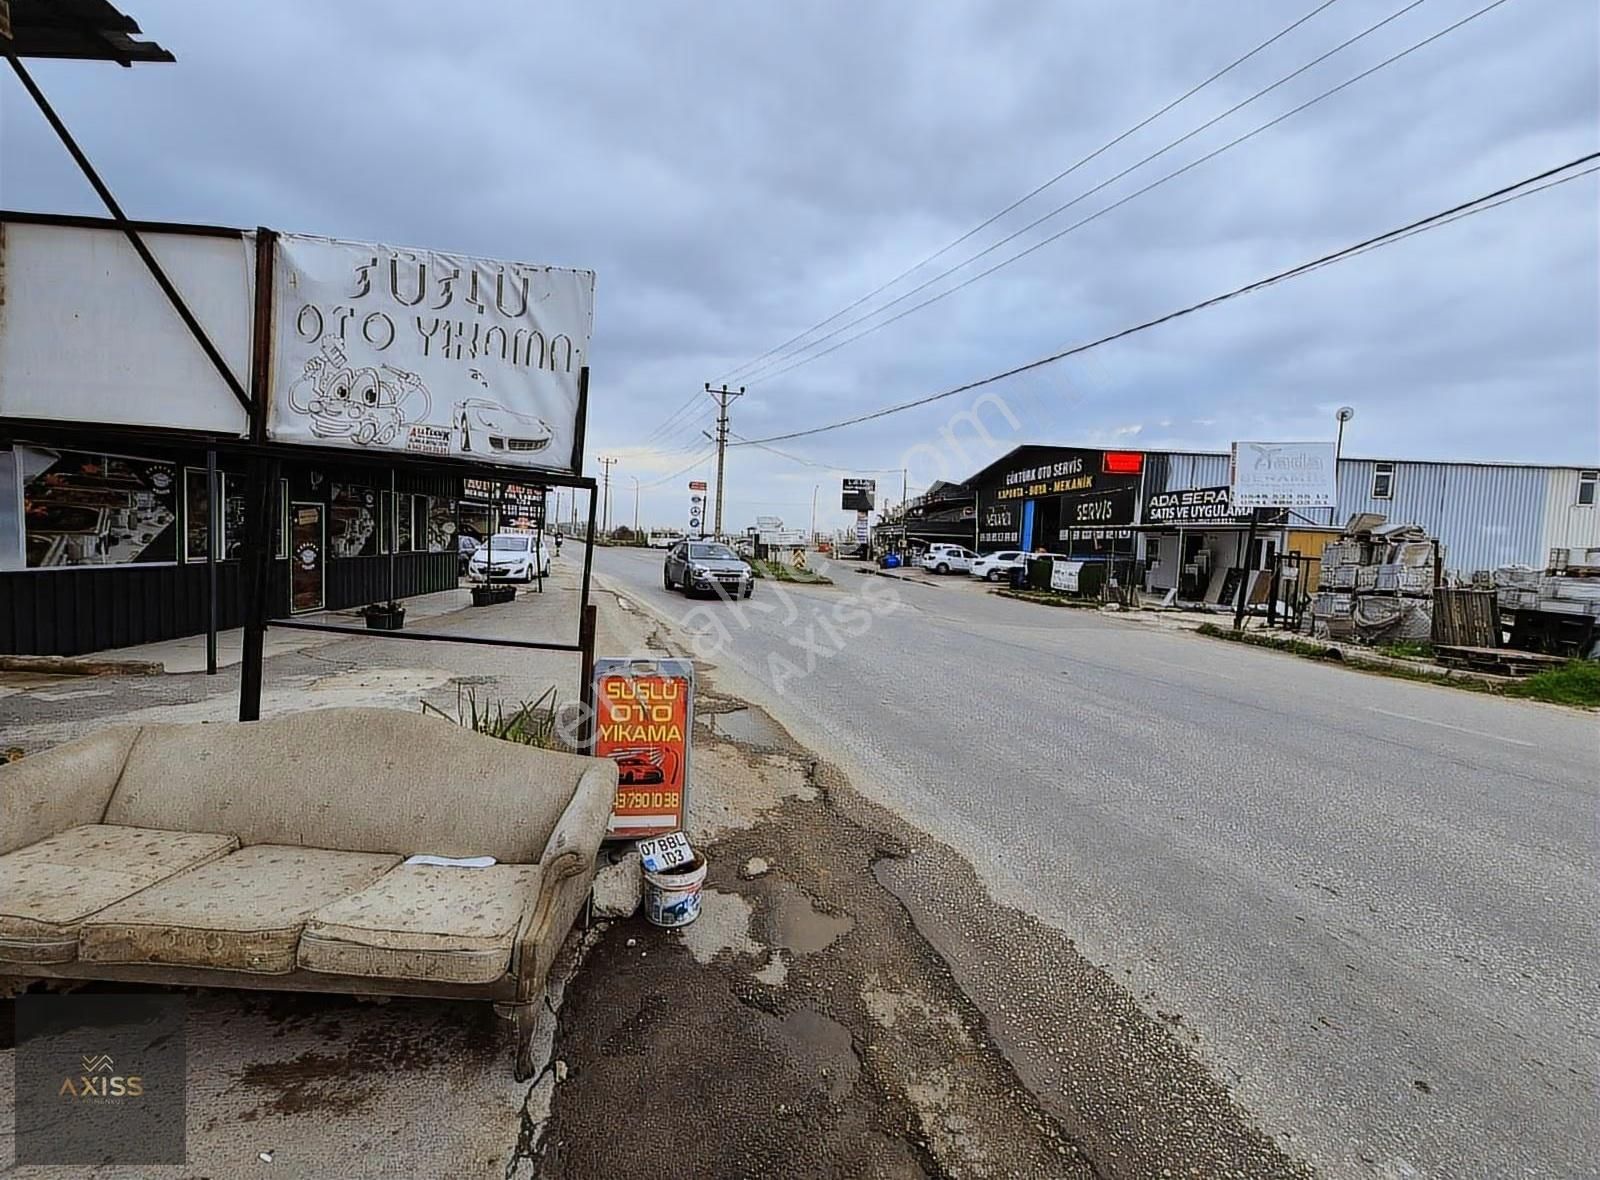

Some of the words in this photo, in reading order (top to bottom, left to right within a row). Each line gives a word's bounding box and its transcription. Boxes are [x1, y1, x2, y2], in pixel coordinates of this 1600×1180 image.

[297, 304, 395, 352] OTO
[1037, 465, 1052, 480] OTO
[1053, 456, 1083, 477] SERVİS
[1053, 474, 1093, 492] MEKANİK
[1149, 494, 1179, 508] ADA
[1181, 489, 1229, 505] SERA
[1176, 506, 1190, 518] VE
[607, 679, 678, 700] SÜSLÜ
[610, 704, 673, 722] OTO
[599, 723, 682, 742] YIKAMA
[640, 841, 657, 856] 07
[657, 834, 687, 852] BBL
